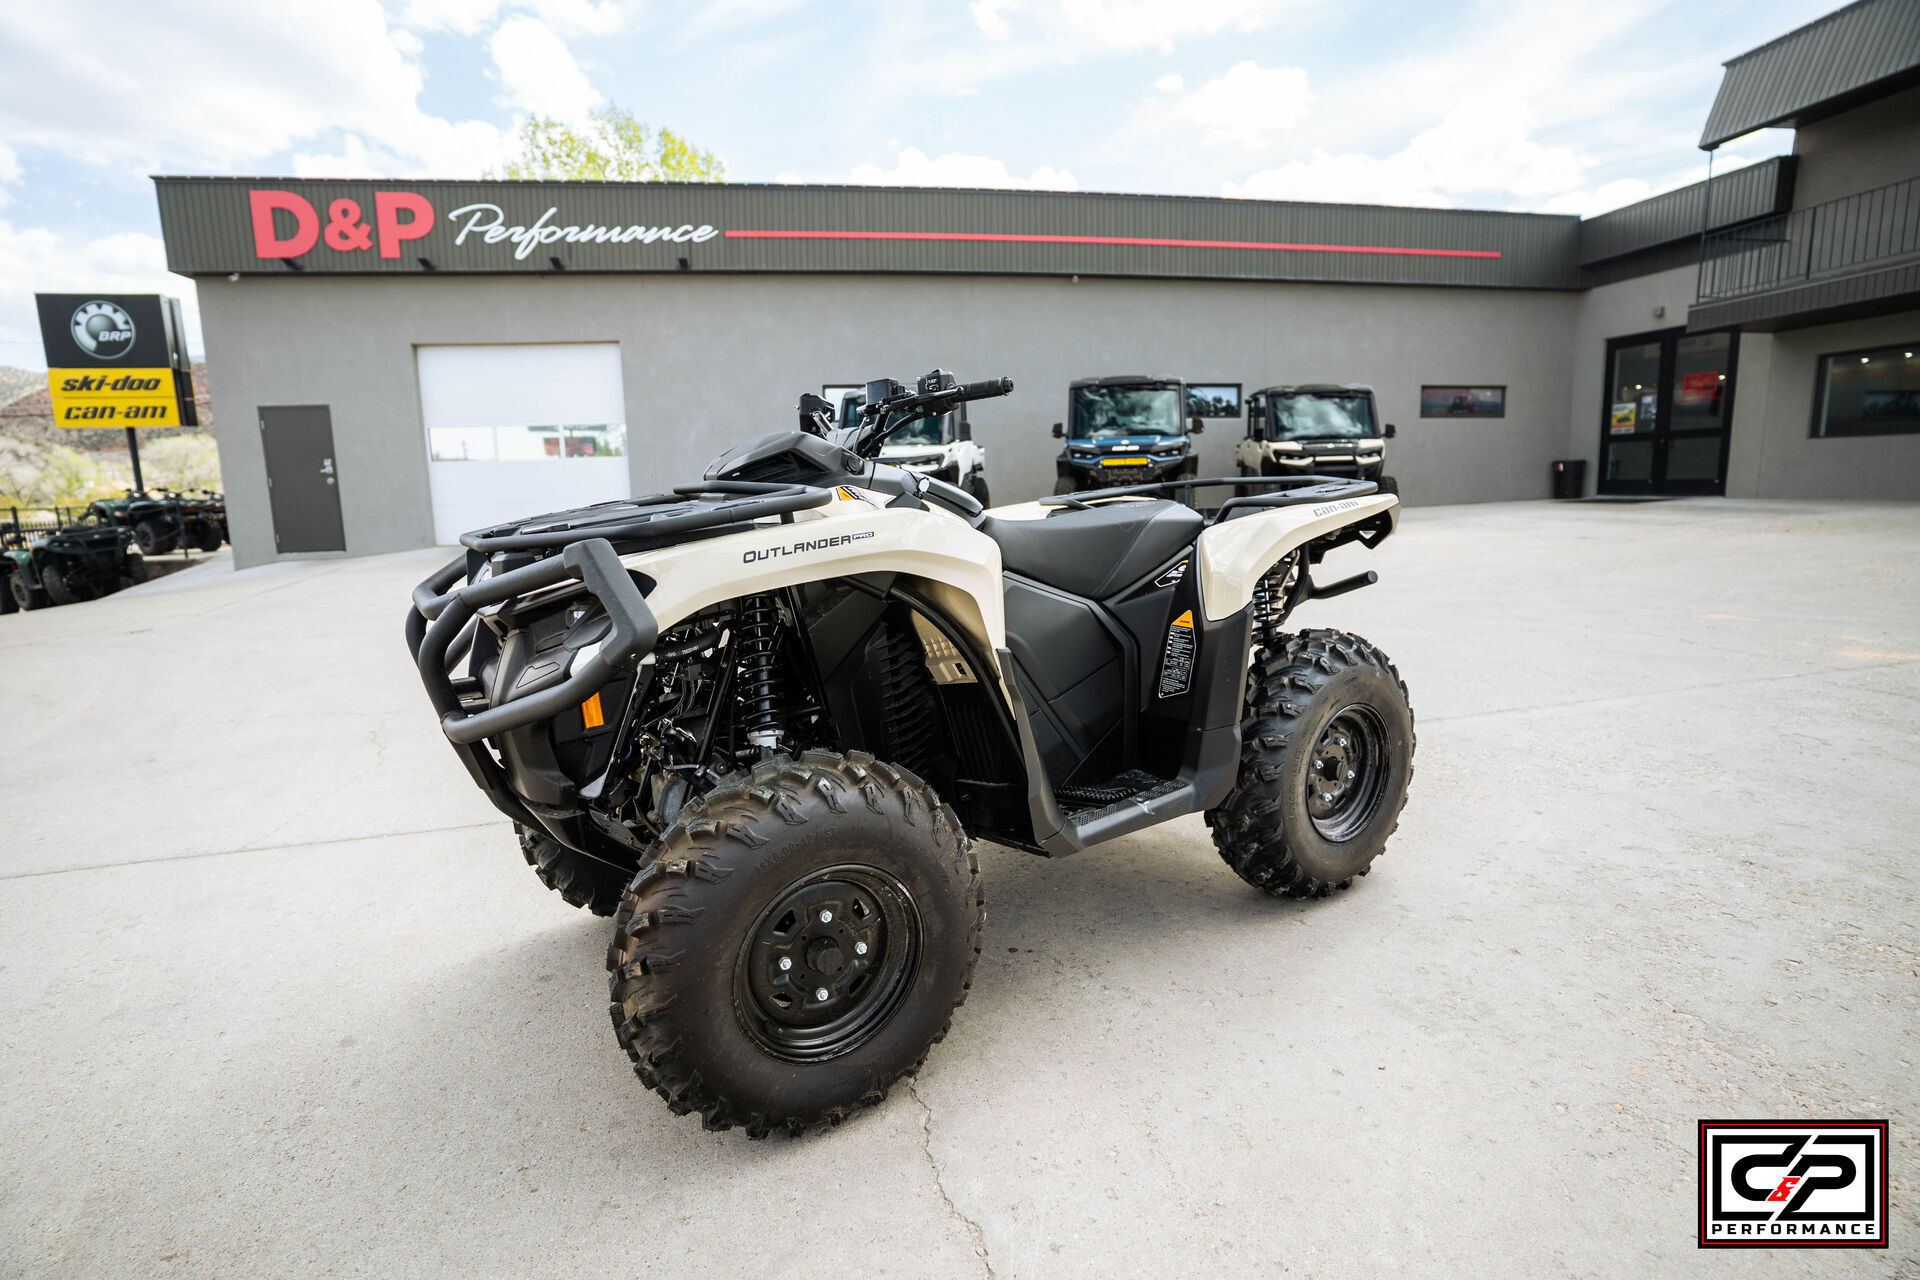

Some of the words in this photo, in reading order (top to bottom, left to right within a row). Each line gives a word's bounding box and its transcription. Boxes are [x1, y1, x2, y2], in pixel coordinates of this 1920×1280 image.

[249, 189, 435, 259] D&P
[448, 203, 719, 260] Performance
[98, 331, 132, 342] BRP
[61, 375, 161, 392] ski-doo
[64, 405, 168, 420] can-am
[1312, 500, 1359, 517] can-am
[852, 532, 874, 540] PRO
